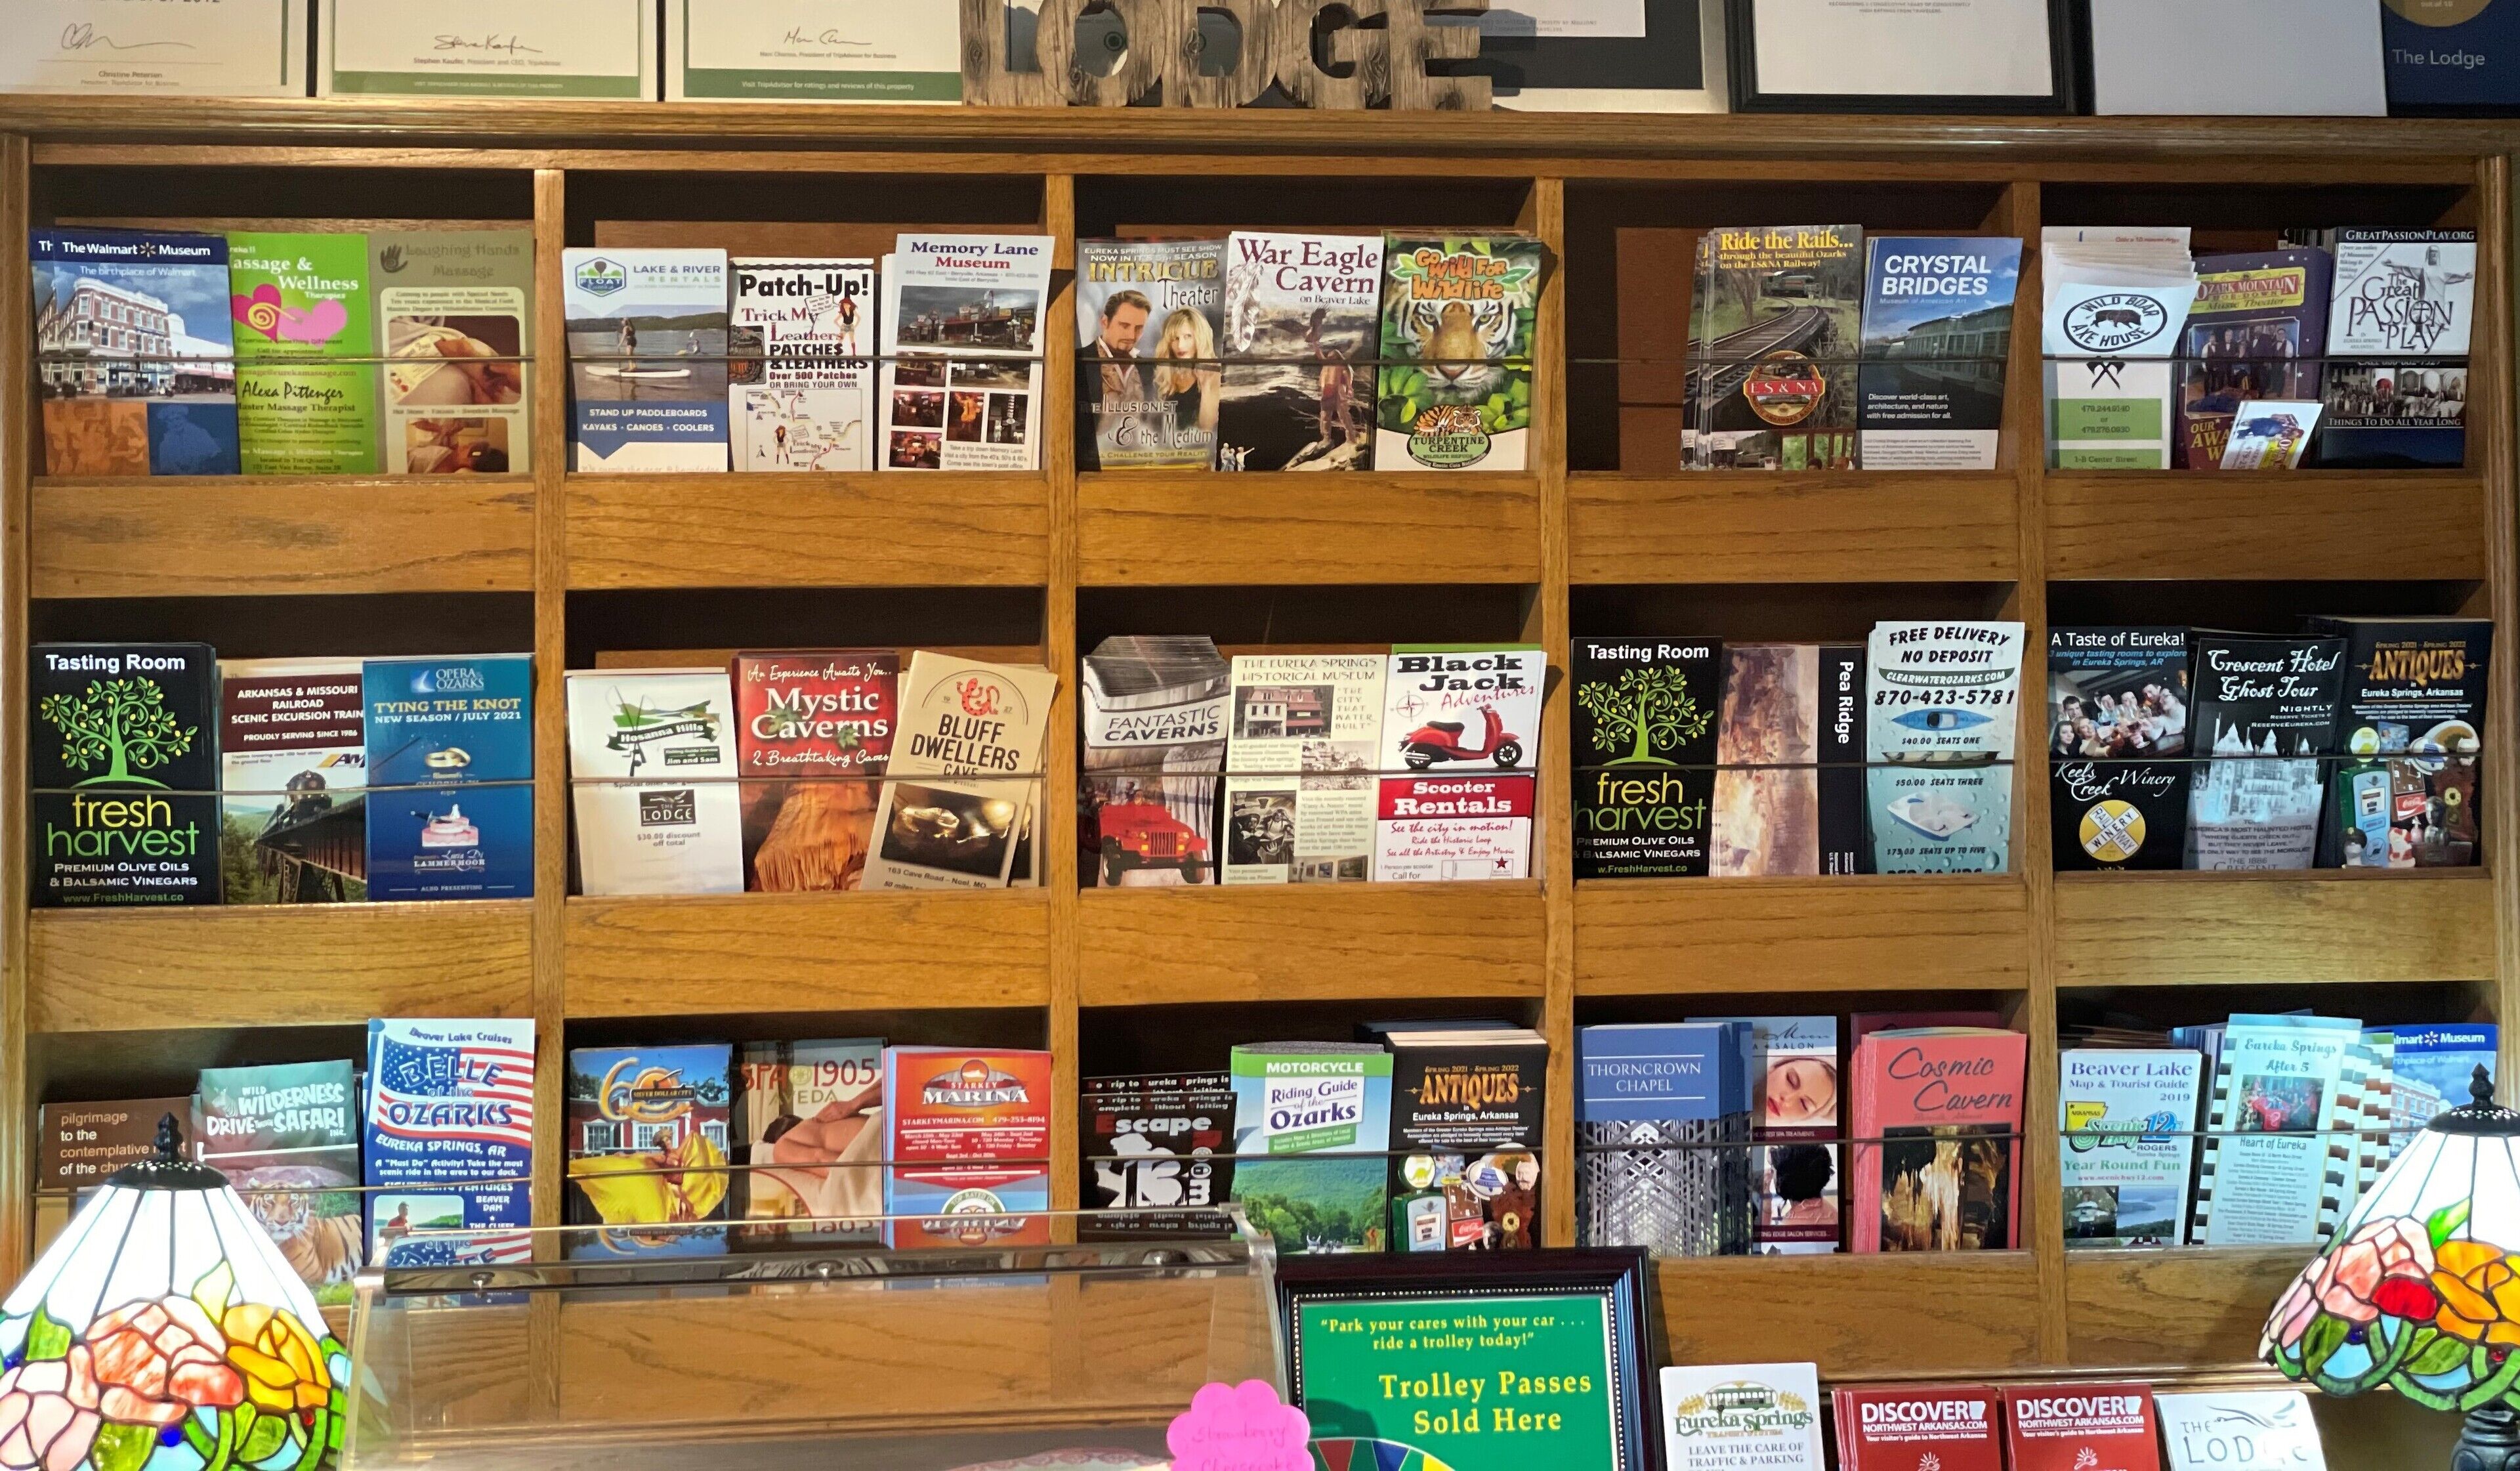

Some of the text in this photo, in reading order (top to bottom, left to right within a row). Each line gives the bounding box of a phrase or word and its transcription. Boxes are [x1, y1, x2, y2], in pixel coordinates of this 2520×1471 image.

[961, 0, 1493, 109] LODGE
[2392, 49, 2485, 69] The Lodge
[62, 242, 85, 253] The
[87, 243, 137, 255] Walmart
[159, 244, 210, 255] Museum
[912, 242, 1039, 257] Memory Lane
[1721, 230, 1854, 251] Ride the Rails...
[405, 244, 520, 257] Laughing Hands
[1237, 238, 1377, 274] War Eagle
[935, 257, 1011, 268] Museum
[1089, 260, 1219, 282] INTRIGUE
[1885, 255, 1992, 274] CRYSTAL
[278, 276, 358, 290] Wellness
[740, 274, 868, 297] Patch-Up!
[1276, 266, 1374, 293] Cavern
[1882, 277, 1988, 295] BRIDGES
[2362, 276, 2419, 301] Great
[1314, 295, 1345, 304] Beaver
[2081, 296, 2160, 316] WILD BOAR
[267, 404, 355, 414] Massage Therapist
[1412, 437, 1484, 445] TURPENTINE
[1429, 444, 1468, 453] CREEK
[1889, 627, 2011, 647] FREE DELIVERY
[2051, 632, 2184, 646] A Taste of Eureka!
[1587, 645, 1709, 662] Tasting Room
[1901, 650, 1993, 662] NO DEPOSIT
[2208, 646, 2342, 672] Crescent Hotel
[46, 654, 185, 673] Tasting Room
[1397, 654, 1522, 673] Black
[1243, 672, 1375, 681] HISTORICAL MUSEUM
[1419, 673, 1524, 691] Jack
[765, 686, 879, 719] Mystic
[1875, 689, 2015, 706] 870-423-5781
[2391, 689, 2424, 698] Springs,
[272, 699, 324, 709] RAILROAD
[374, 698, 521, 713] TYING THE KNOT
[1108, 705, 1221, 729] FANTASTIC
[751, 714, 889, 739] Caverns
[938, 714, 1005, 743] BLUFF
[1104, 721, 1218, 741] CAVERNS
[910, 733, 1020, 771] DWELLERS
[1413, 781, 1496, 794] Scooter
[1597, 773, 1683, 805] fresh
[73, 794, 171, 827] fresh
[1394, 797, 1511, 815] Rentals
[48, 822, 199, 856] harvest
[55, 863, 189, 872] PREMIUM OLIVE OILS
[50, 877, 198, 886] & BALSAMIC VINEGARS
[409, 1028, 512, 1044] Beaver Lake Cruises
[2441, 1034, 2485, 1043] Museum
[2244, 1038, 2337, 1058] Eureka Springs
[1266, 1062, 1364, 1073] MOTORCYCLE
[1588, 1062, 1701, 1077] THORNCROWN
[1888, 1048, 1994, 1080] Cosmic
[2072, 1062, 2193, 1076] Beaver Lake
[741, 1058, 875, 1091] SPA 1905
[1616, 1079, 1673, 1092] CHAPEL
[2069, 1080, 2093, 1090] Map
[2154, 1080, 2189, 1088] Guide
[238, 1083, 345, 1116] WILDERNESS
[1913, 1080, 2012, 1111] Cavern
[61, 1112, 127, 1126] pilgrimage
[1096, 1113, 1211, 1136] Escape
[1270, 1103, 1356, 1130] Ozarks
[1444, 1113, 1478, 1122] Springs,
[60, 1144, 149, 1159] contemplative
[1370, 1319, 1403, 1334] your
[1410, 1318, 1447, 1329] cares
[1454, 1316, 1487, 1327] with
[1494, 1316, 1526, 1329] your
[1533, 1315, 1555, 1326] car
[1379, 1371, 1591, 1402] Trolley Passes
[1414, 1408, 1561, 1434] Sold Here
[1864, 1421, 1987, 1432] NORTHWEST ARKANSAS.COM
[2019, 1415, 2144, 1428] NORTHWEST ARKANSAS.COM
[2181, 1421, 2212, 1434] THE
[1689, 1446, 1725, 1455] LEAVE
[1729, 1445, 1753, 1453] THE
[1785, 1442, 1803, 1451] OF
[1687, 1457, 1736, 1467] TRAFFIC
[1752, 1455, 1803, 1464] PARKING
